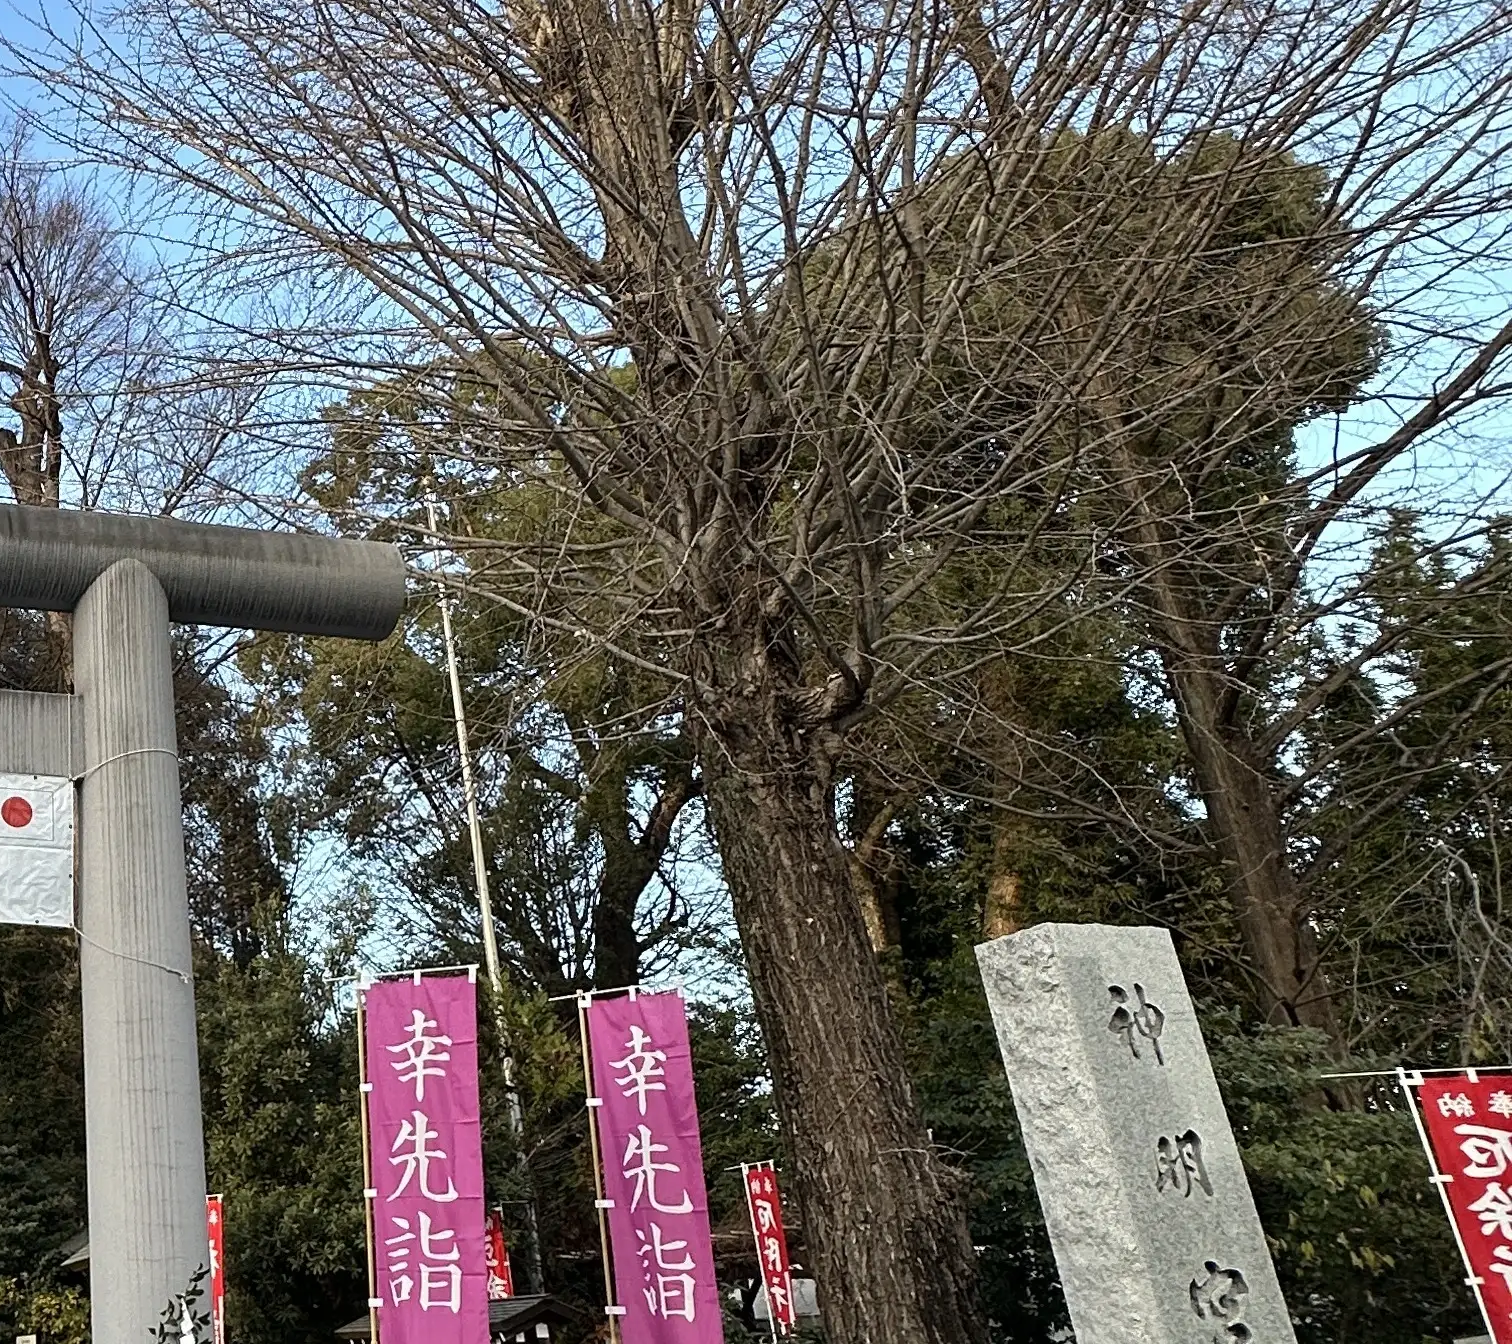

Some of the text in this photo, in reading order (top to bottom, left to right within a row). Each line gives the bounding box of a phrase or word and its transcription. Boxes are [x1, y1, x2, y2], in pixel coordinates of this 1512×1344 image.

[384, 1008, 464, 1313] 幸先詣
[607, 1026, 696, 1323] 幸先詣
